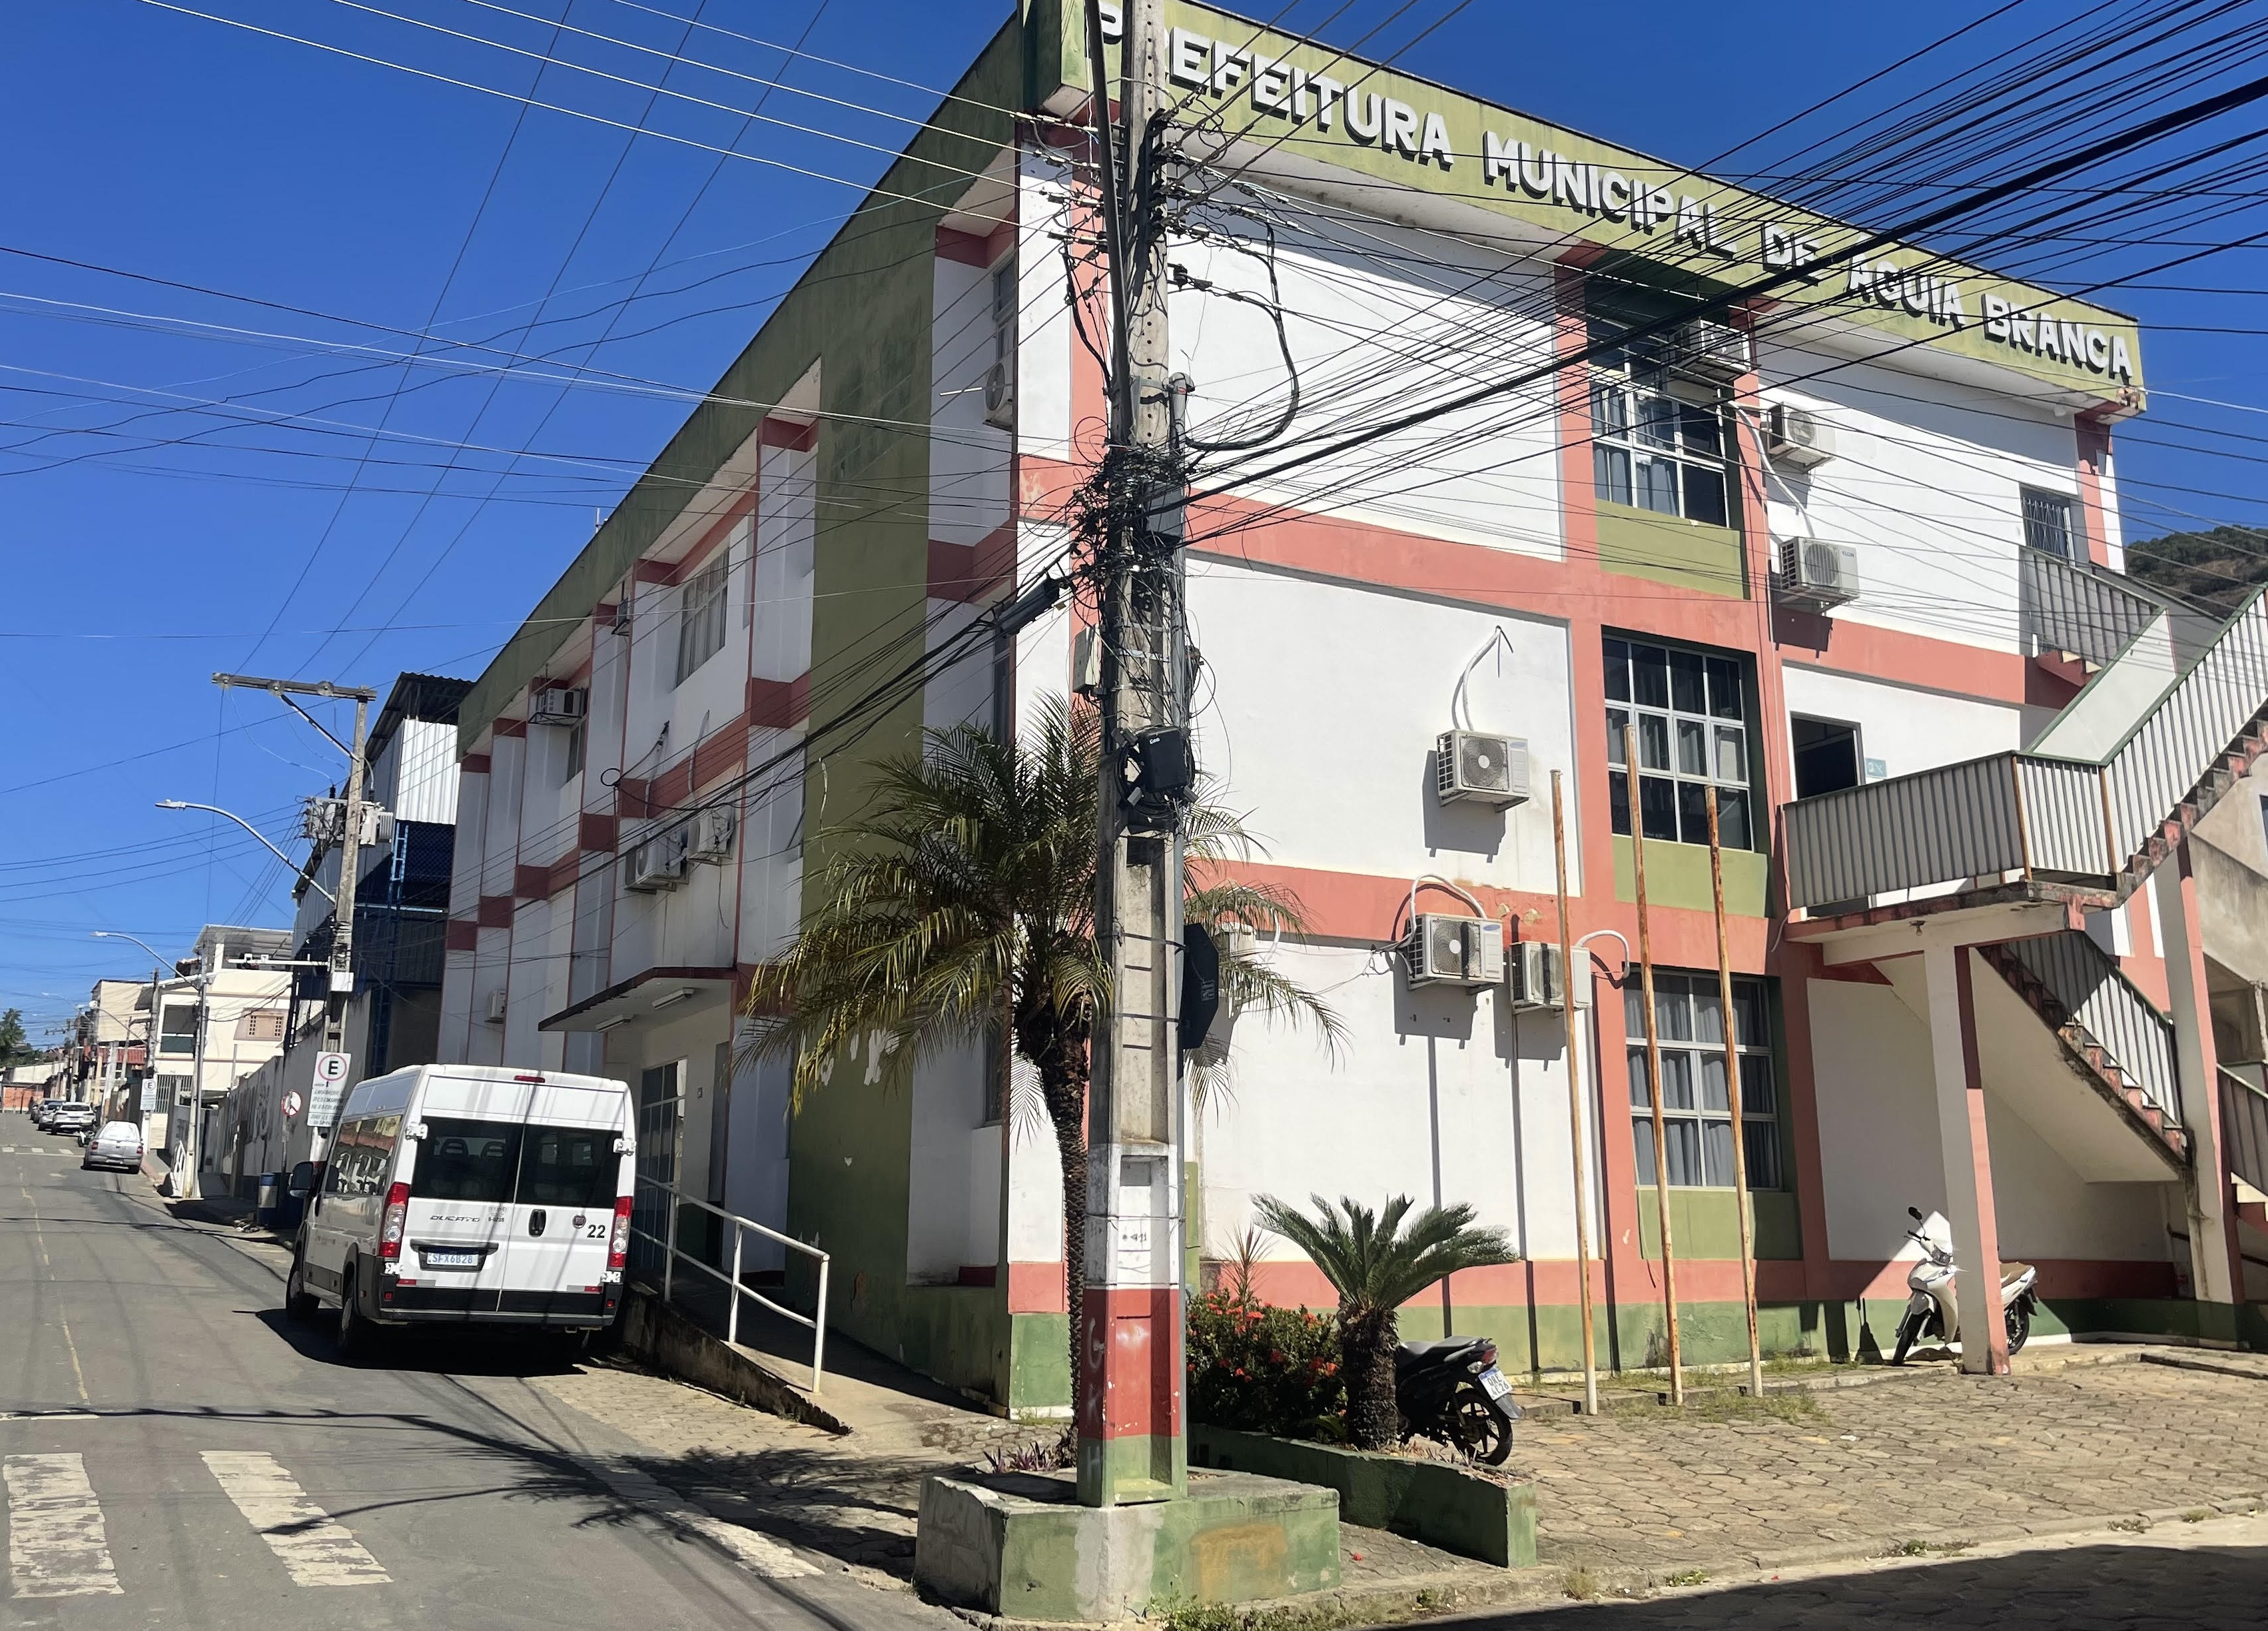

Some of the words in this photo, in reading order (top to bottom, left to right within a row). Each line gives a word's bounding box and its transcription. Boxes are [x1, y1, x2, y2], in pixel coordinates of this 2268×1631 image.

[1086, 0, 1454, 170] PEFEITURA
[1483, 131, 1736, 259] MUNICIPAL
[1761, 222, 1820, 285] DE
[1982, 293, 2133, 382] BRANCA
[328, 1061, 338, 1075] E
[587, 1225, 605, 1238] 22
